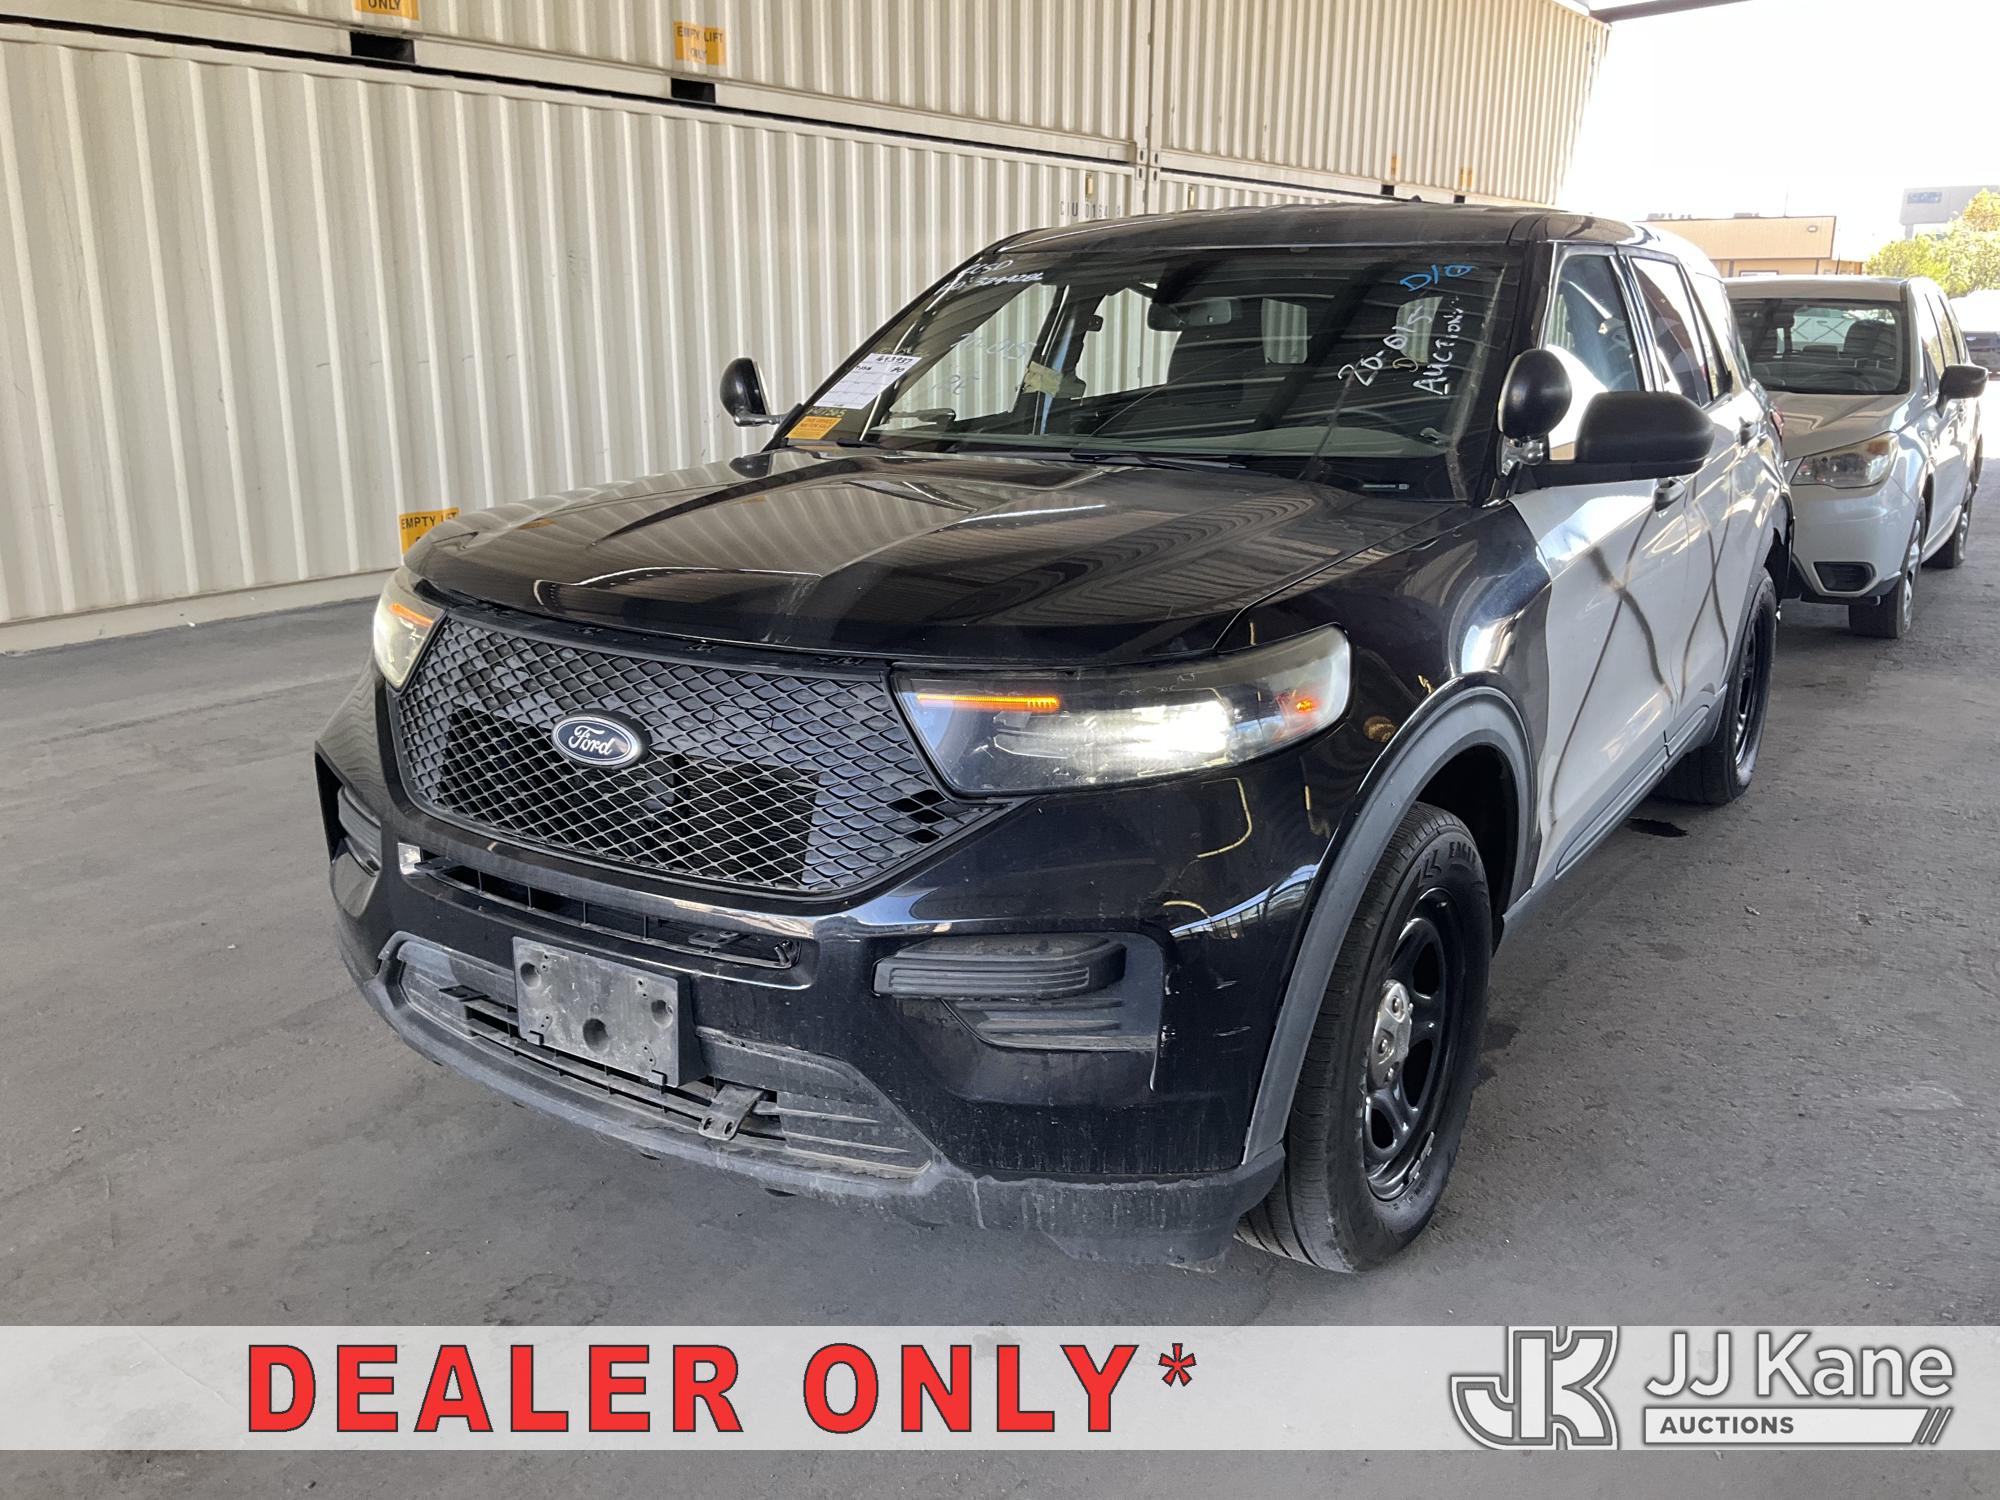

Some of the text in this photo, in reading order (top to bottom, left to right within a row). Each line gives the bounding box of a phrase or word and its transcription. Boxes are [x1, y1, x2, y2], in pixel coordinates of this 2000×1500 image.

[368, 0, 400, 10] ONLY
[703, 31, 723, 42] LIFT
[401, 515, 435, 529] EMPTY
[567, 725, 615, 756] Ford
